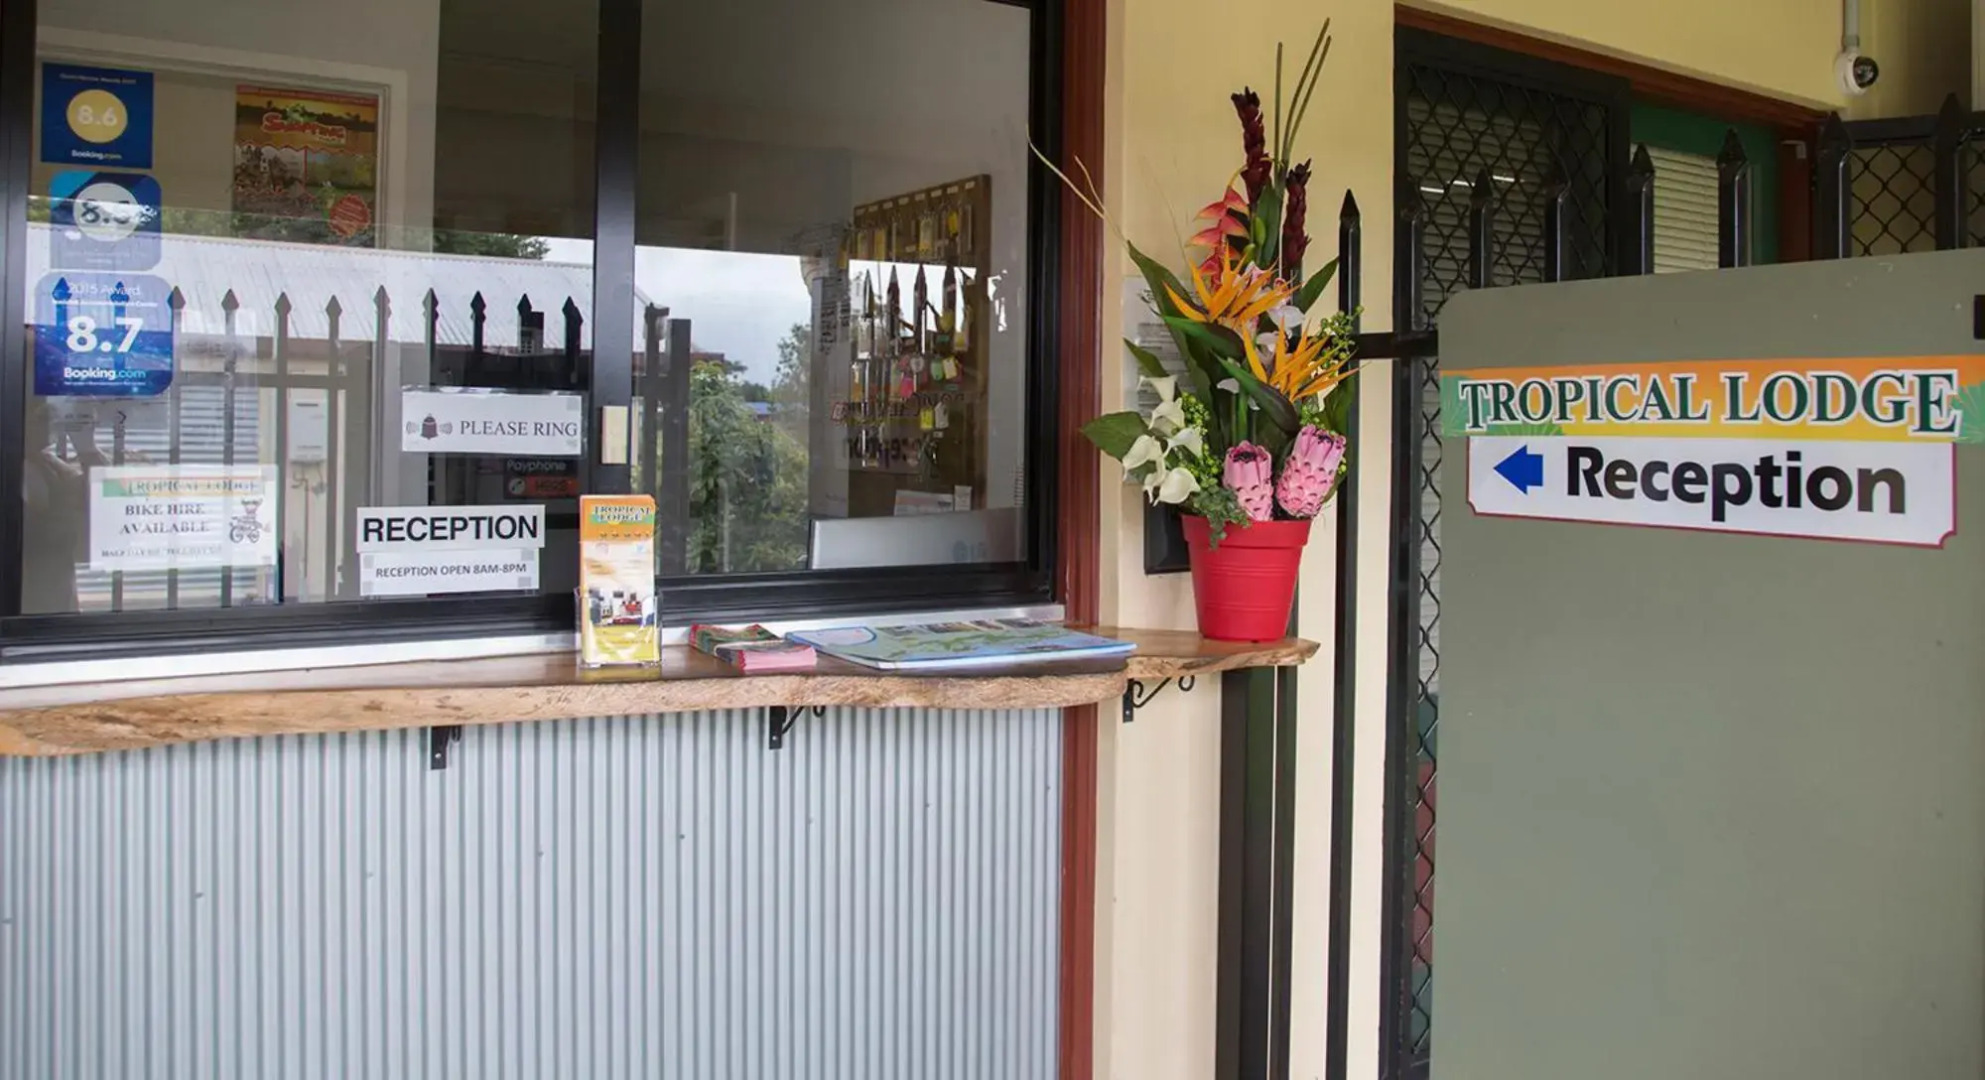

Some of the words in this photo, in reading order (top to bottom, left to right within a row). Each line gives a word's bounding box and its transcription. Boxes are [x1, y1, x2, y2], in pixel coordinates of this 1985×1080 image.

[77, 105, 118, 126] 8.6
[68, 281, 98, 295] 2015
[66, 315, 144, 353] 8.7
[64, 367, 146, 380] Booking.com
[1458, 372, 1709, 430] TROPICAL
[1721, 369, 1961, 437] LODGE
[460, 420, 528, 437] PLEASE
[533, 420, 578, 437] RING
[506, 459, 566, 475] Payphone
[1566, 445, 1906, 523] Reception
[125, 504, 164, 516] BIKE
[167, 503, 206, 515] HIRE
[119, 520, 210, 535] AVAILABLE
[363, 514, 538, 543] RECEPTION
[375, 566, 437, 579] RECEPTION
[440, 564, 471, 577] OPEN
[473, 562, 527, 575] 8AM-8PM
